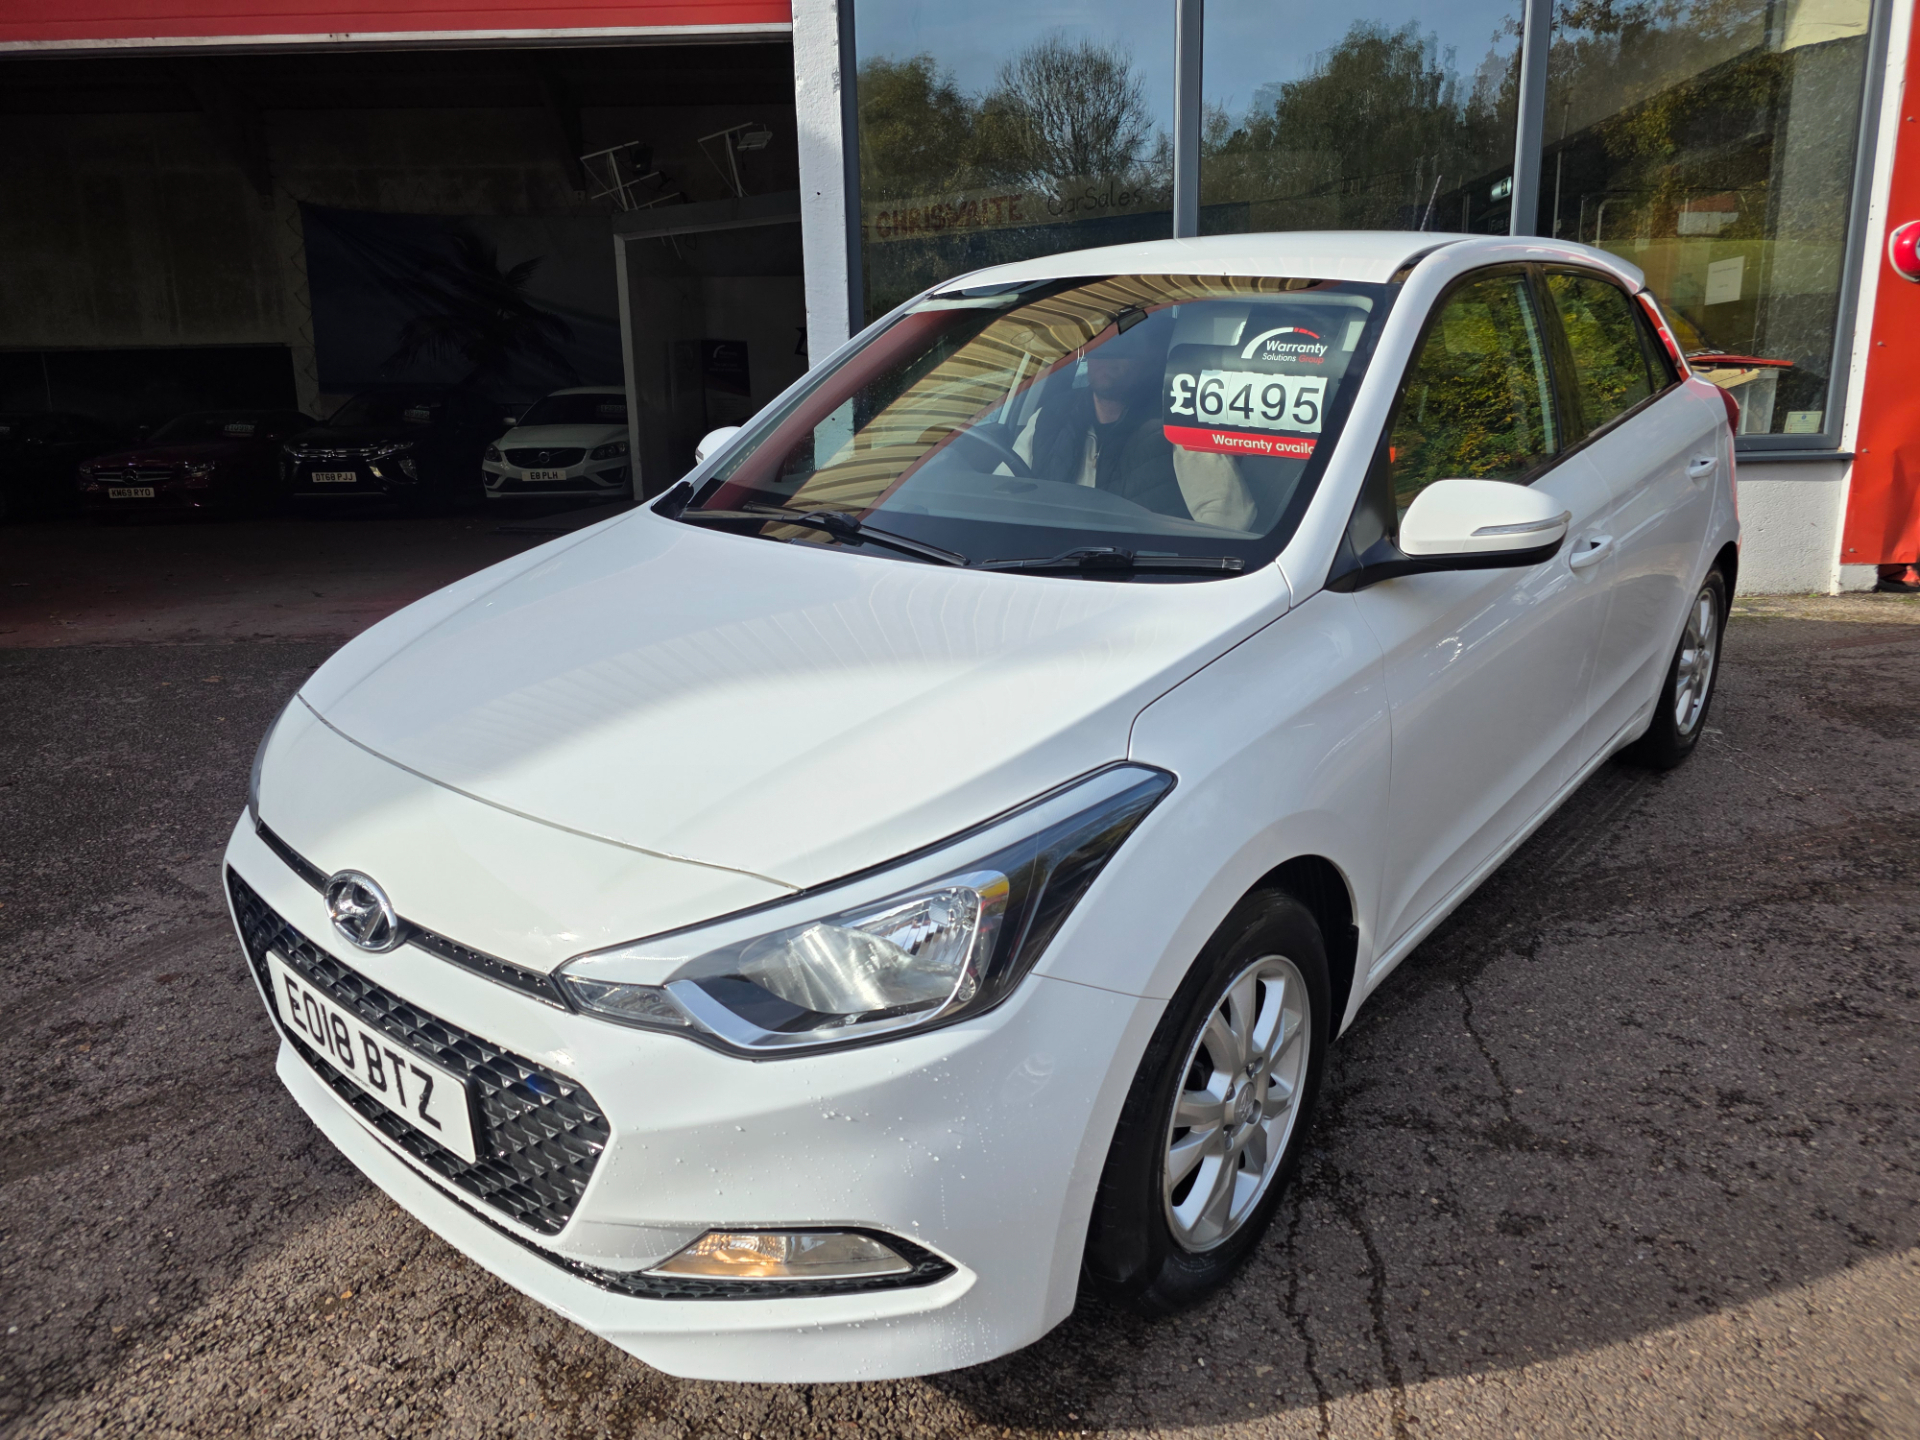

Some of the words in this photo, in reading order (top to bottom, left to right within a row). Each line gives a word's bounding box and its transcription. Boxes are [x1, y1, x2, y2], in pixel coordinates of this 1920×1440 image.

[1266, 340, 1328, 357] Warranty
[1261, 352, 1297, 362] Solutions
[1298, 354, 1325, 365] Group
[1170, 373, 1320, 425] £6495
[1212, 433, 1273, 453] Warranty
[337, 473, 353, 481] PJJ
[542, 471, 559, 480] PLH
[283, 972, 356, 1070] EO18
[358, 1030, 443, 1132] BTZ
